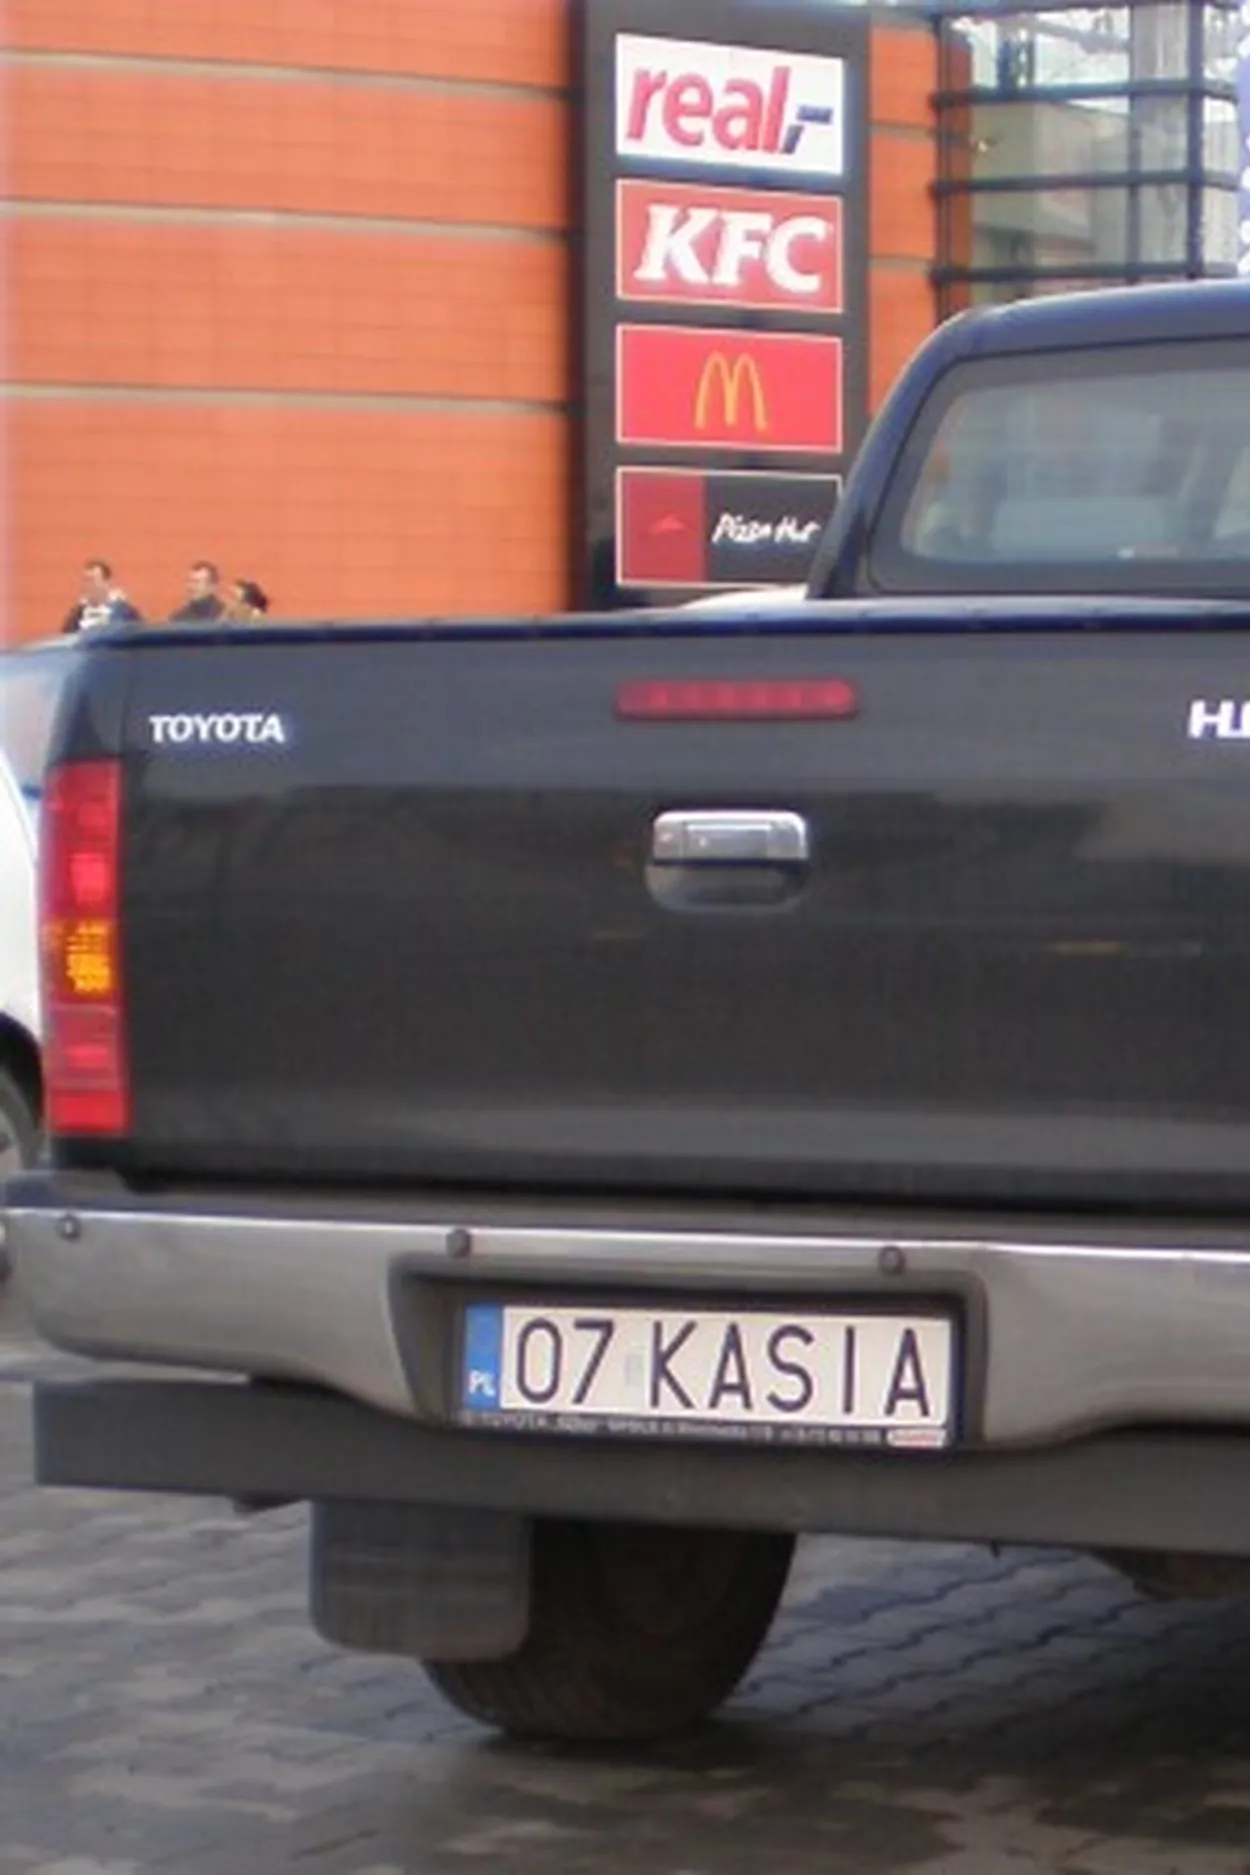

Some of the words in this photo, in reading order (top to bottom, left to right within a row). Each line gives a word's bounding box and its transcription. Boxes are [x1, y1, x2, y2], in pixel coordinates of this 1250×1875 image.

[633, 203, 829, 294] KFC
[149, 713, 286, 743] TOYOTA
[468, 1370, 497, 1397] PL
[650, 1321, 930, 1417] KASIA
